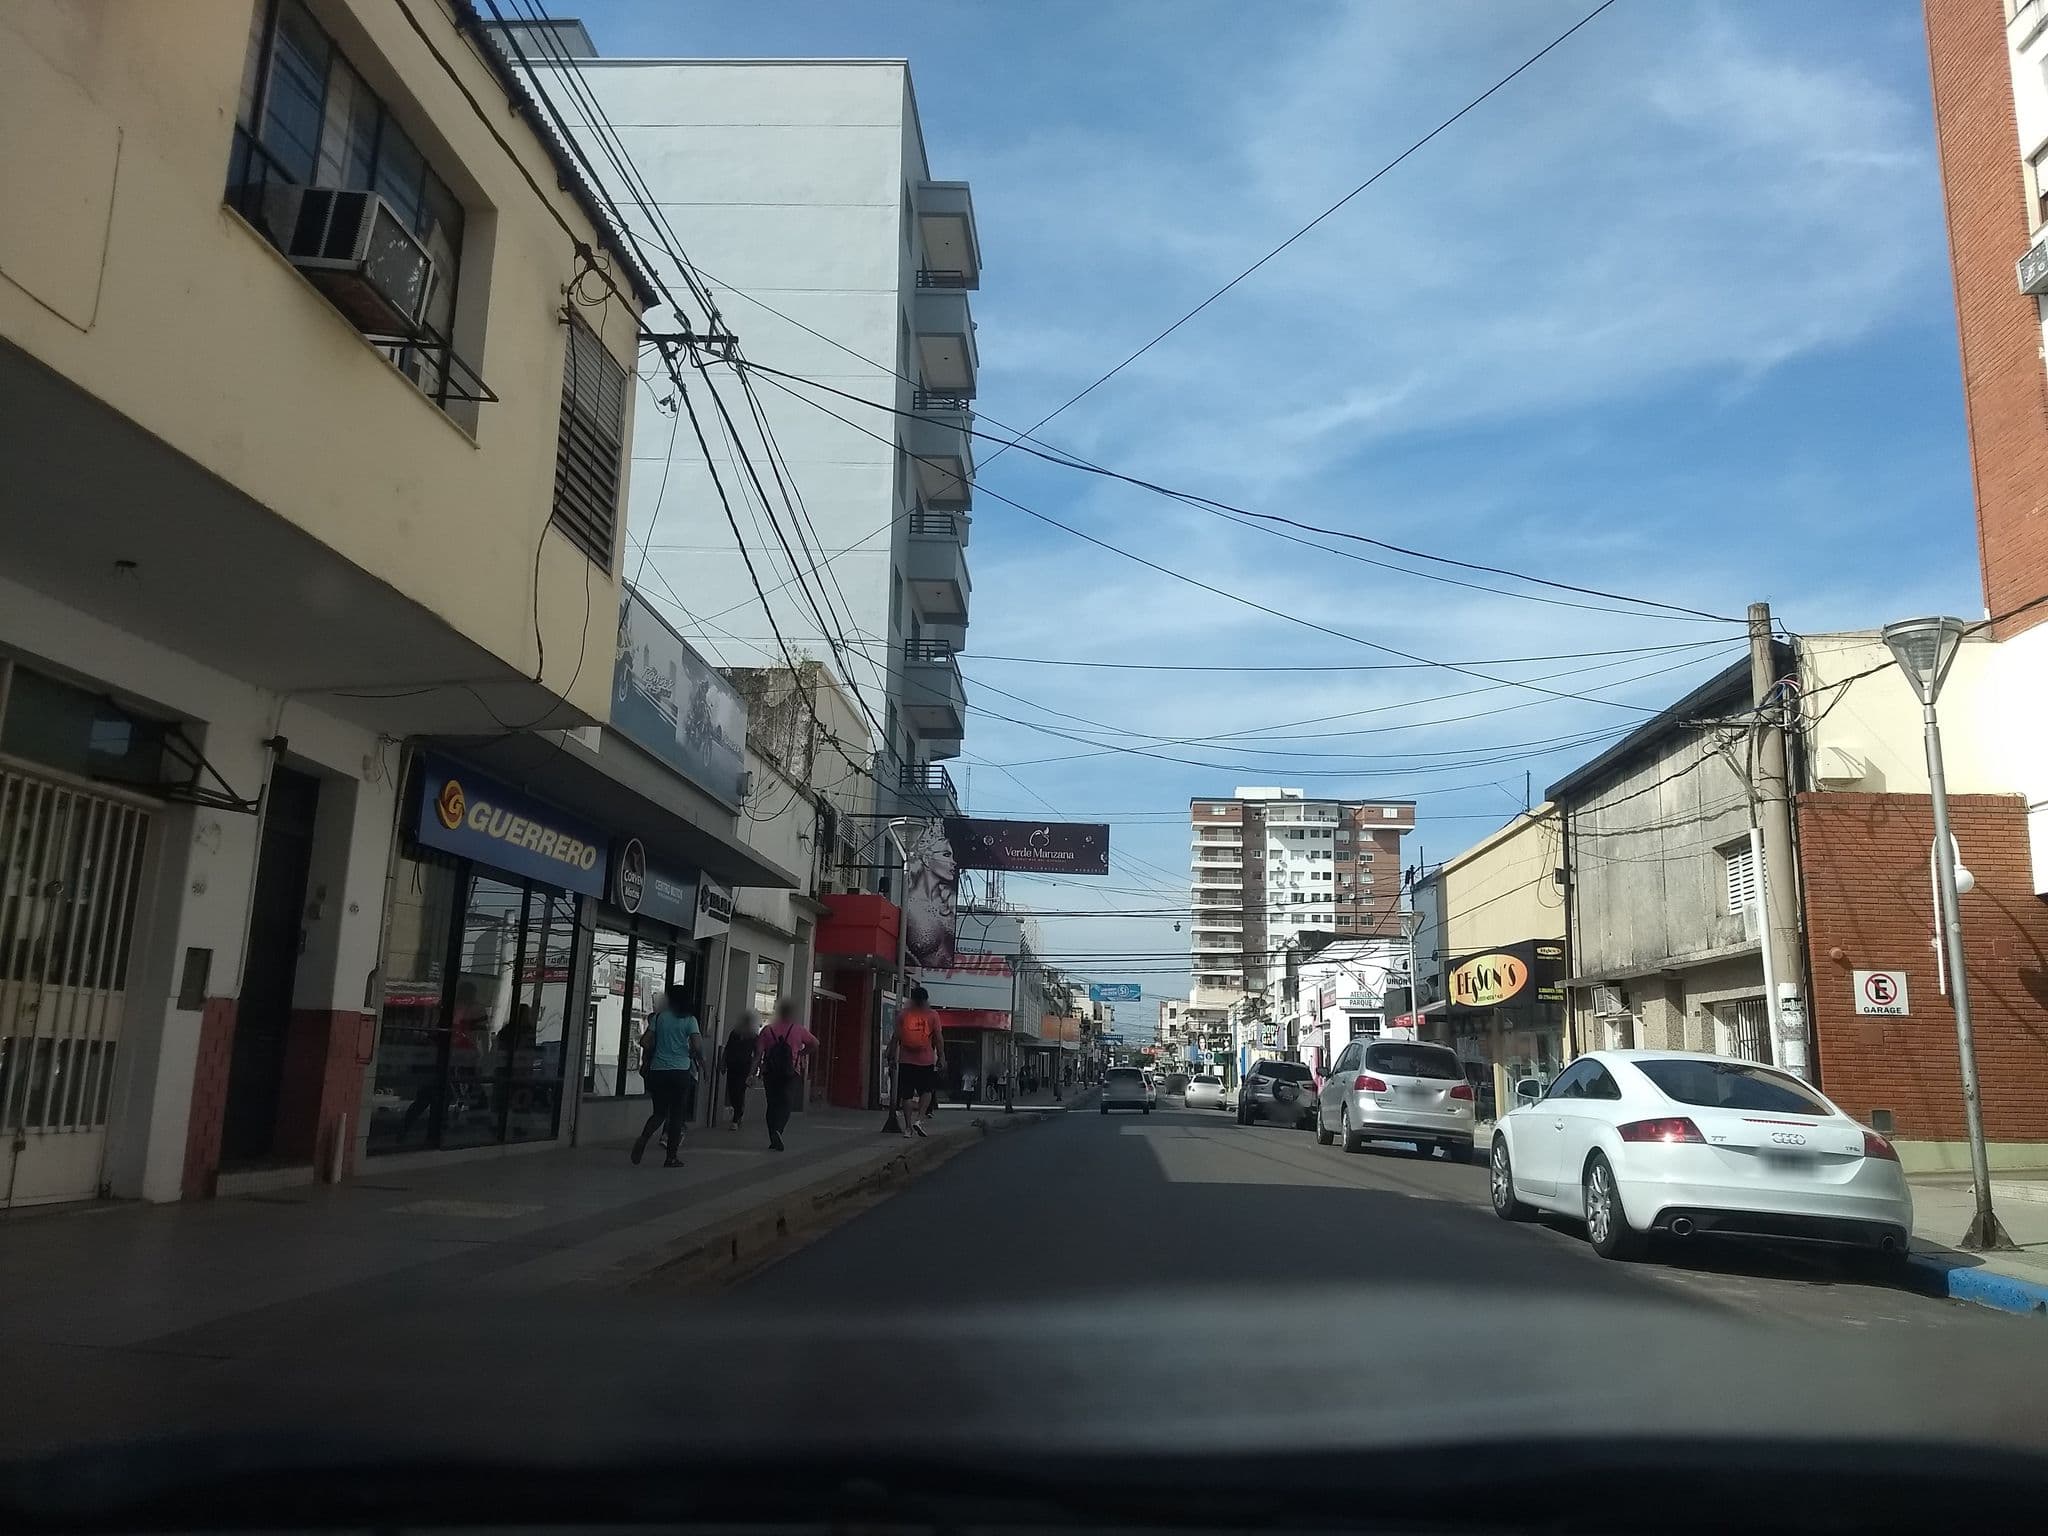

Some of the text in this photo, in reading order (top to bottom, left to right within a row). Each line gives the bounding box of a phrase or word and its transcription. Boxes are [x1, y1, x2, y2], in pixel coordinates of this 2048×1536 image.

[467, 801, 597, 871] GUERRERO
[1004, 847, 1032, 858] Verde
[1033, 848, 1075, 860] Manzana
[1349, 999, 1373, 1007] PARQUE
[1863, 1006, 1903, 1014] GARAGE
